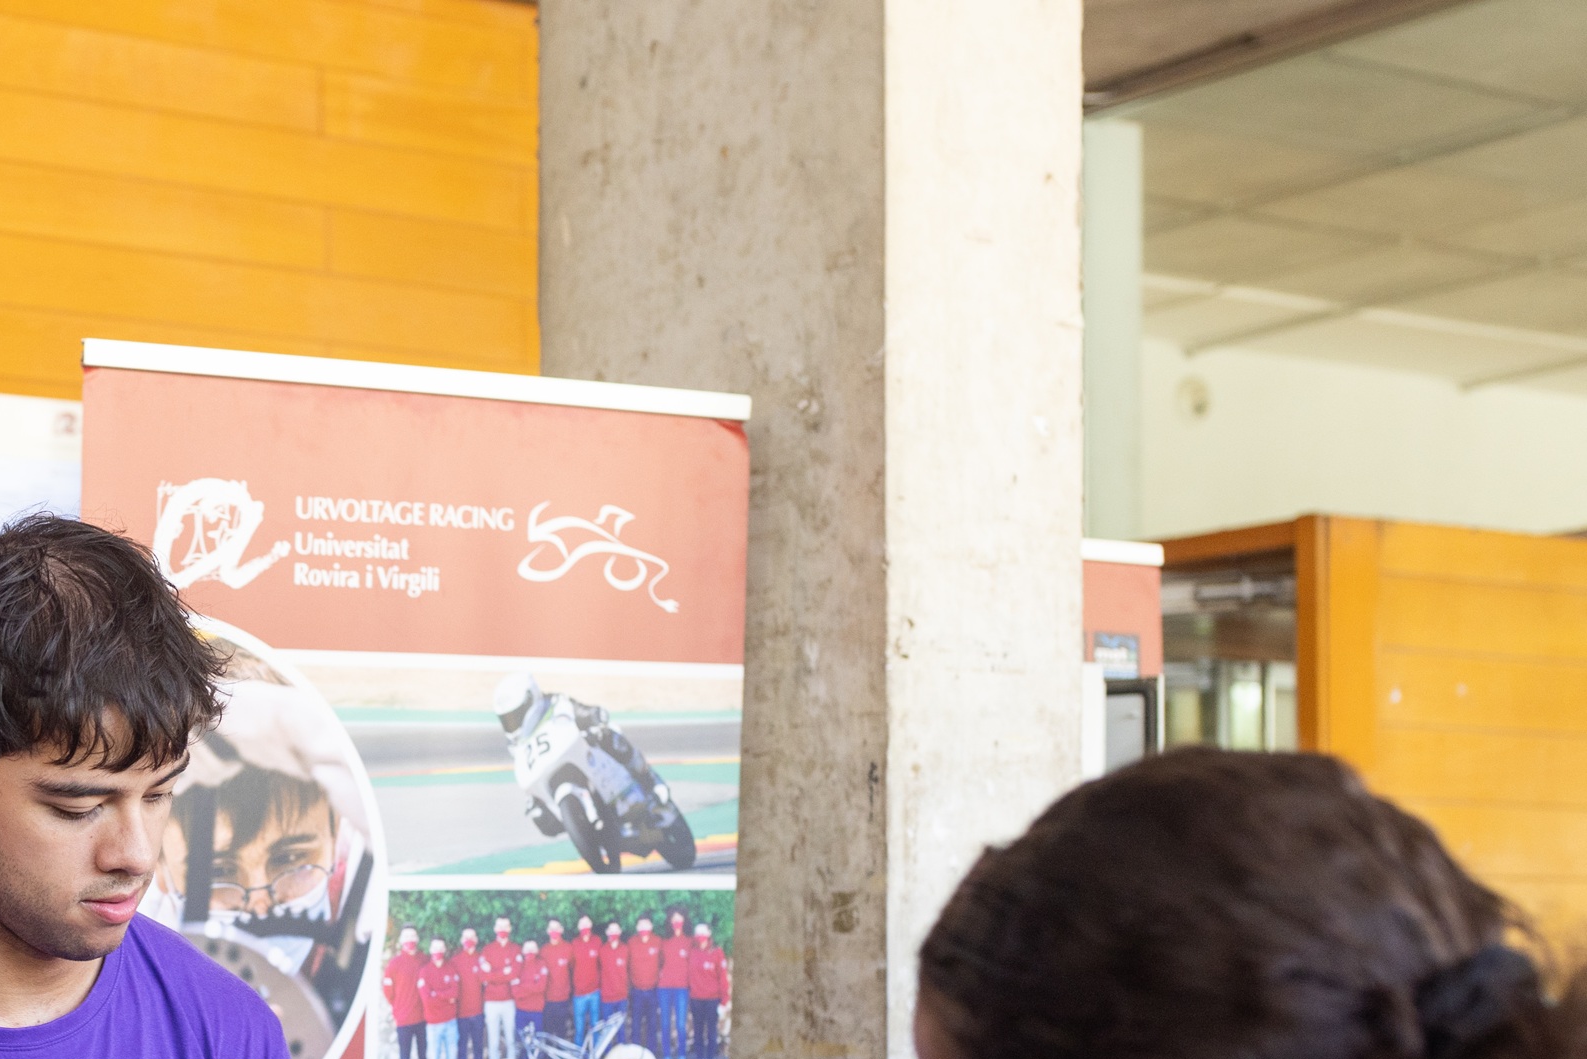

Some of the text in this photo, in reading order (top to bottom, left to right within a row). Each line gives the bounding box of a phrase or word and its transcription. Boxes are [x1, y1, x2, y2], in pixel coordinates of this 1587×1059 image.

[295, 495, 516, 532] URVOLTAGE RACING
[294, 531, 410, 561] Universitat
[293, 562, 440, 598] Rovira i Virgili
